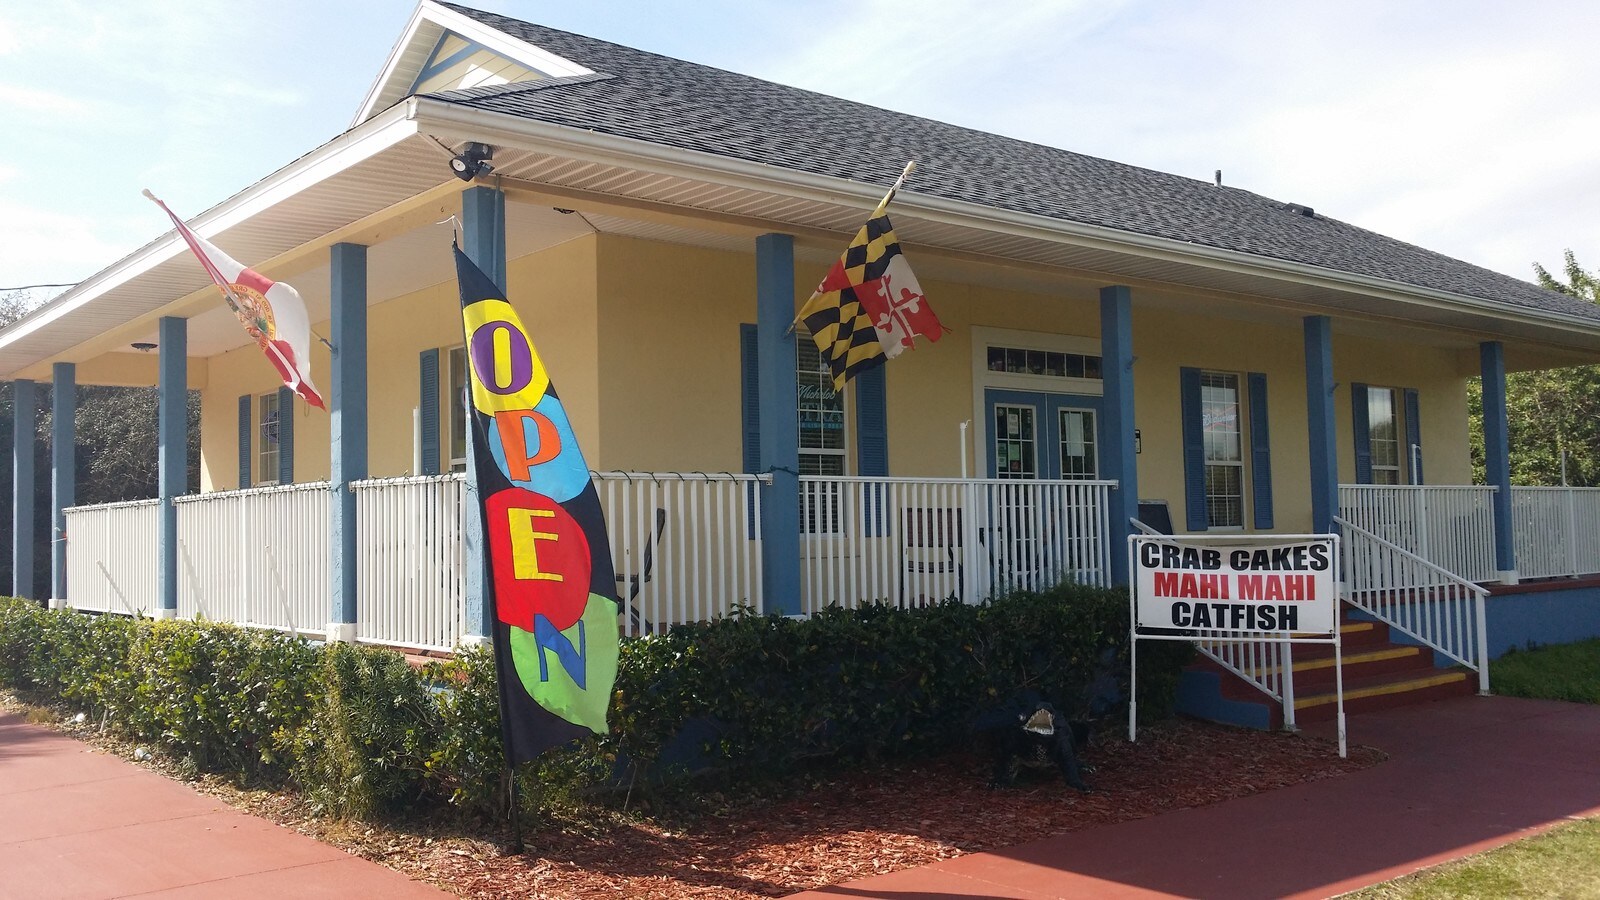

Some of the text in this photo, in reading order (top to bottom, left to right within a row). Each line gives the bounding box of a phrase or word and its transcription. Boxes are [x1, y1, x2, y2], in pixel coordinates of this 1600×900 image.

[798, 384, 836, 400] Michlob
[470, 320, 587, 692] OPEN
[1140, 542, 1329, 571] CRAB CAKES
[1154, 571, 1316, 601] MAHI MAHI
[1171, 601, 1298, 631] CATFISH
